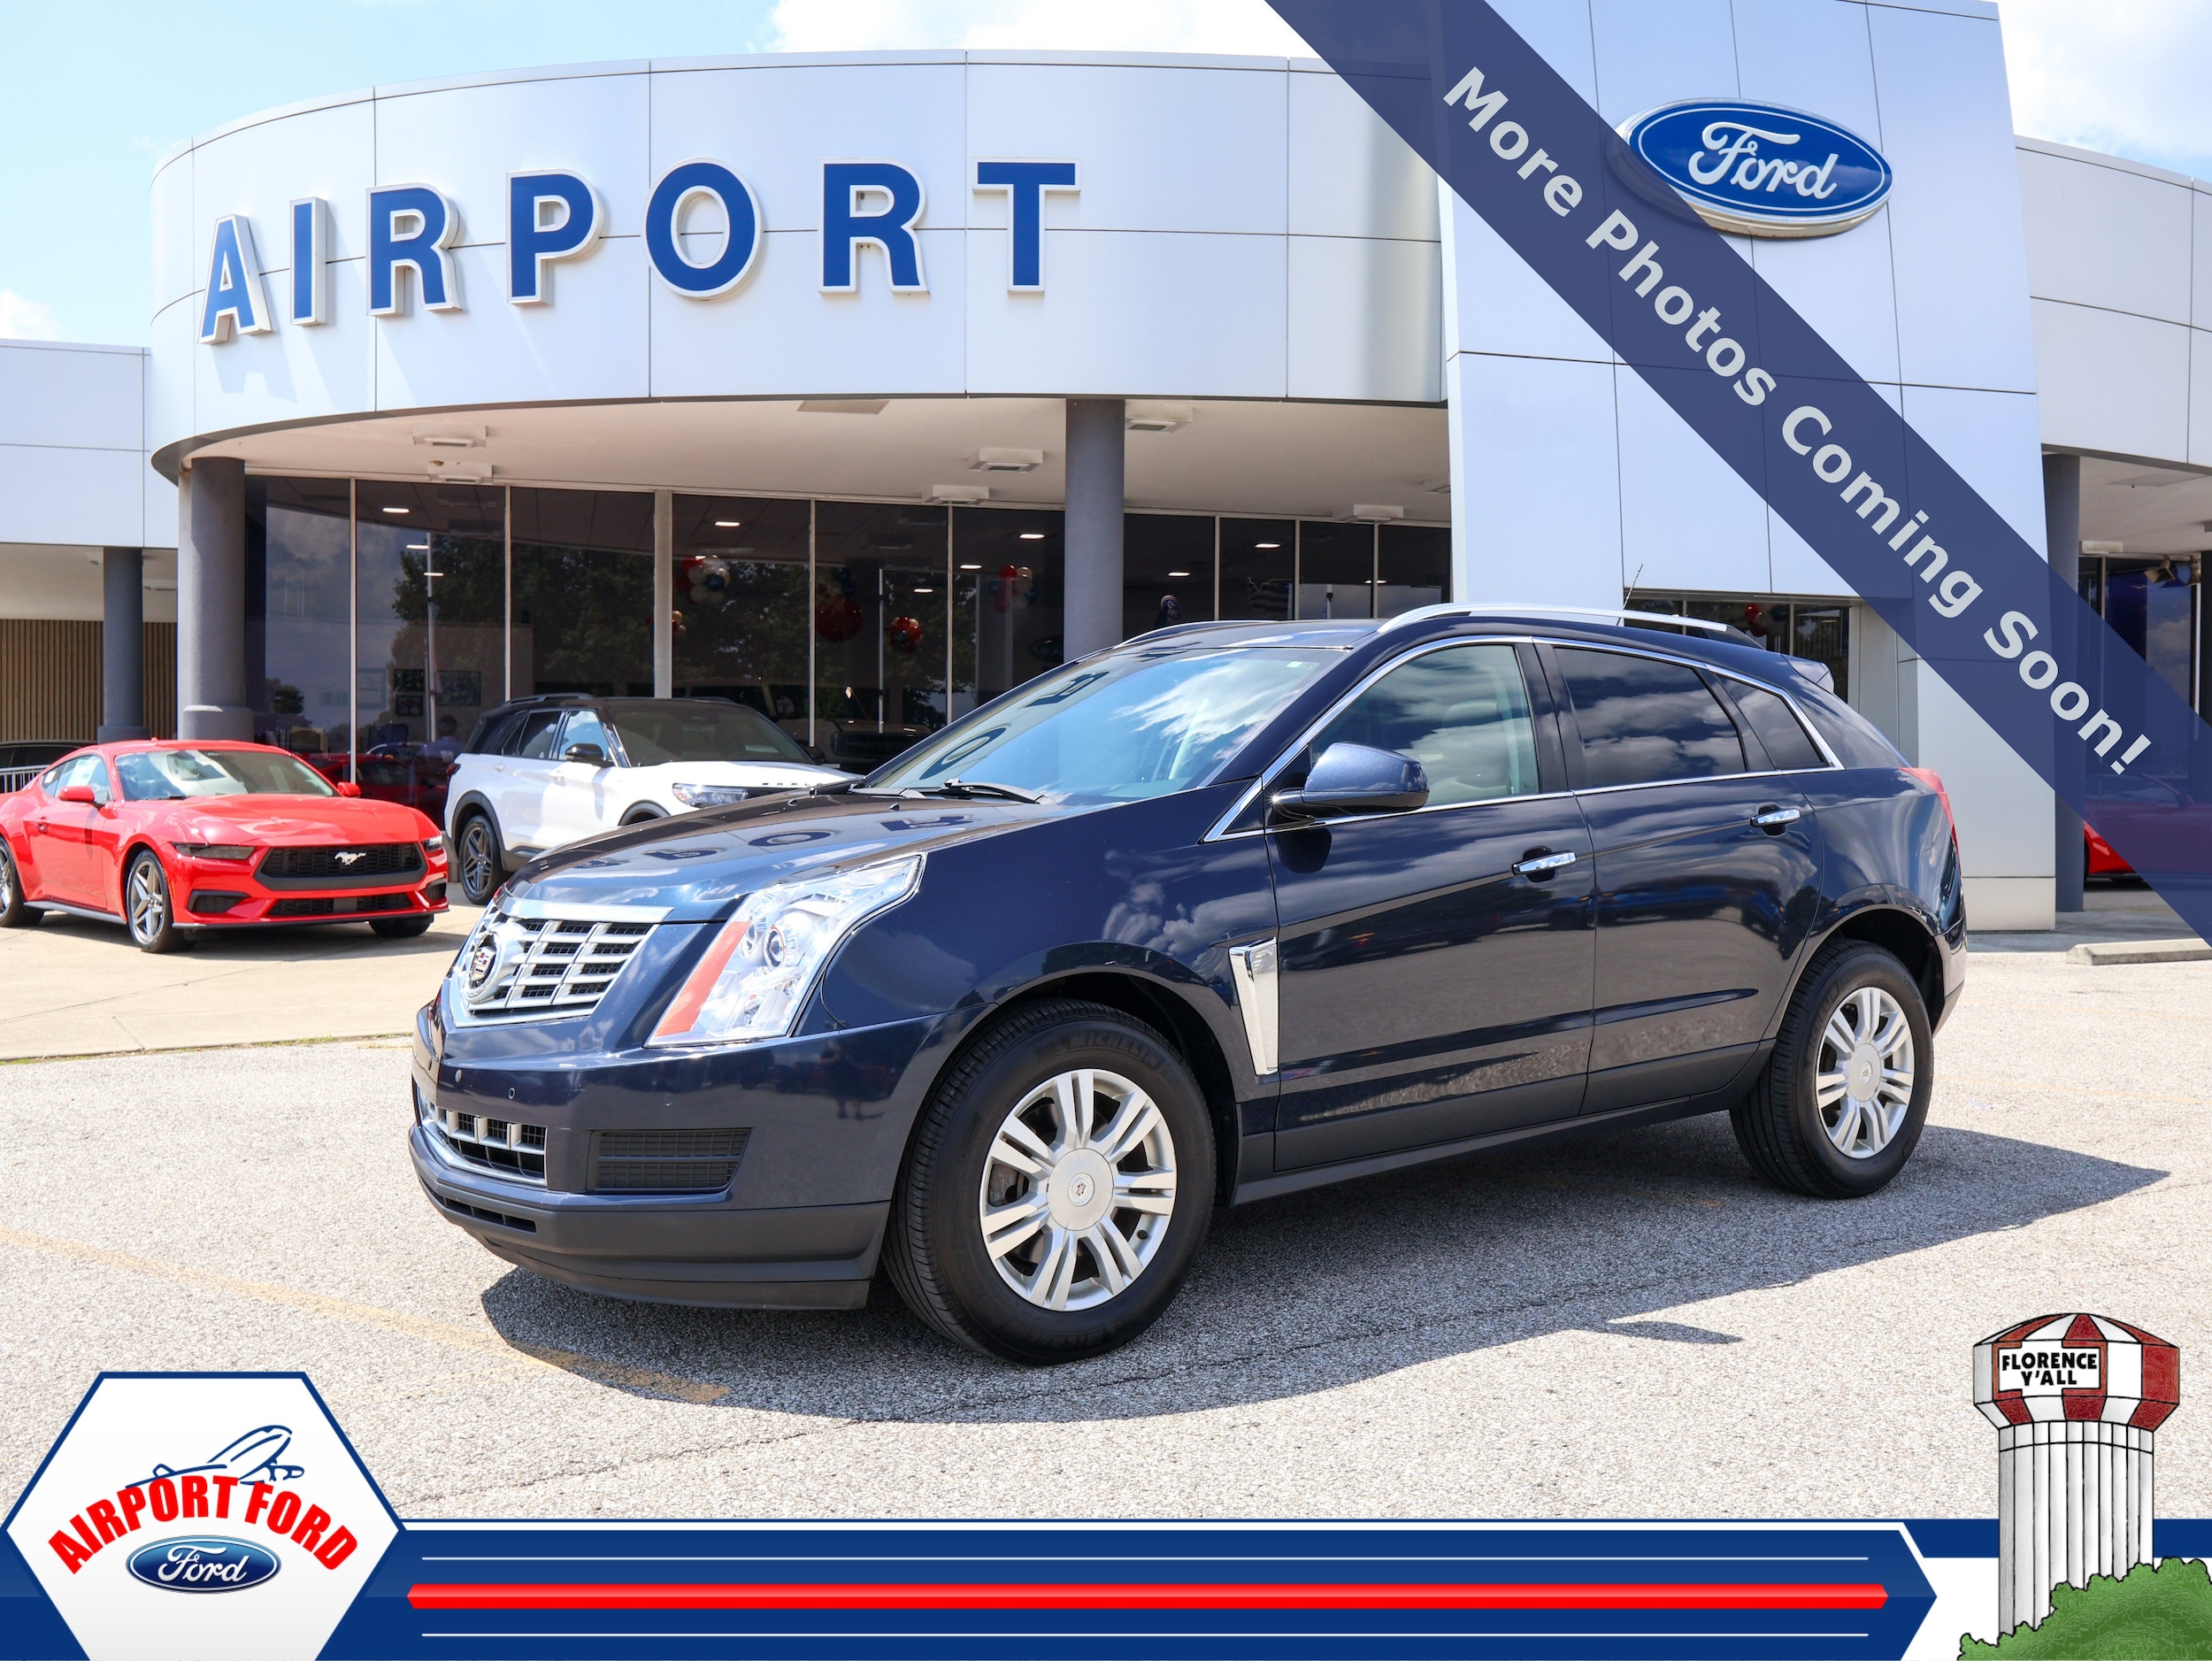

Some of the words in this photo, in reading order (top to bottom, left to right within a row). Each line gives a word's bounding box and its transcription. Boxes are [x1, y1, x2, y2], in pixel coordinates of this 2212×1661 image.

[1688, 121, 1838, 200] Ford
[199, 157, 1080, 344] AIRPORT
[1069, 1030, 1164, 1070] MICHELIN
